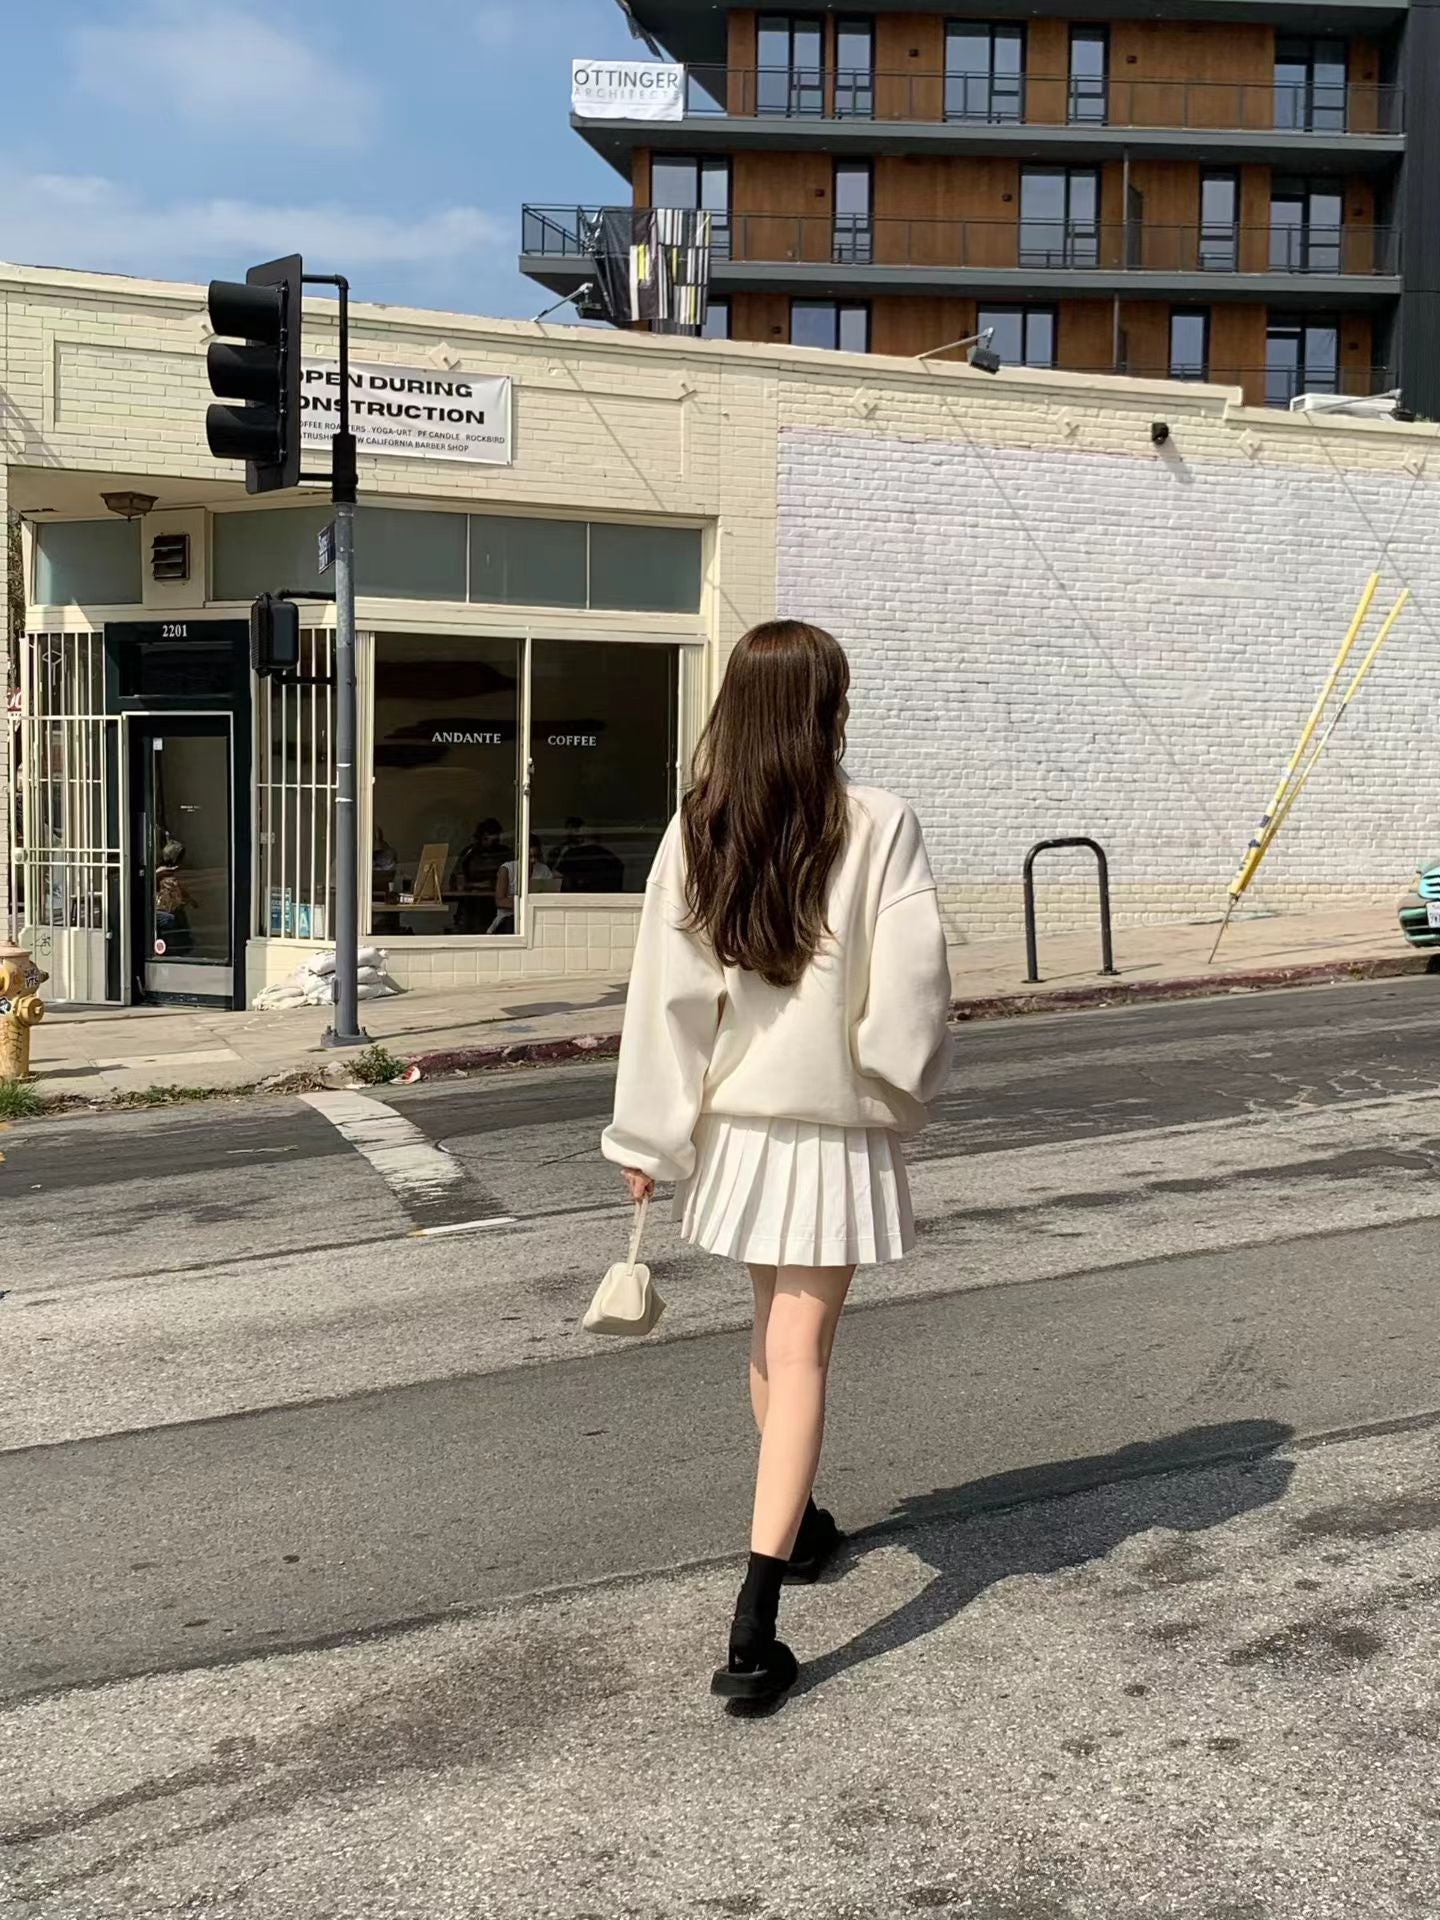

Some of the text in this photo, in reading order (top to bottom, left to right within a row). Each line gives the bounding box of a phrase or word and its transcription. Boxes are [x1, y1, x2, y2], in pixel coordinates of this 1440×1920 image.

[574, 69, 679, 88] OTTINGER
[300, 370, 473, 398] PEN DURING
[371, 426, 412, 437] YOGA-URT
[428, 431, 460, 440] CANDLE
[466, 434, 505, 444] ROCKBIRD
[366, 437, 413, 448] CALIFORNIA
[415, 441, 446, 450] BARBER
[447, 443, 469, 452] SHOP
[162, 624, 188, 638] 2201
[432, 732, 597, 746] ANDANTE COFFEE
